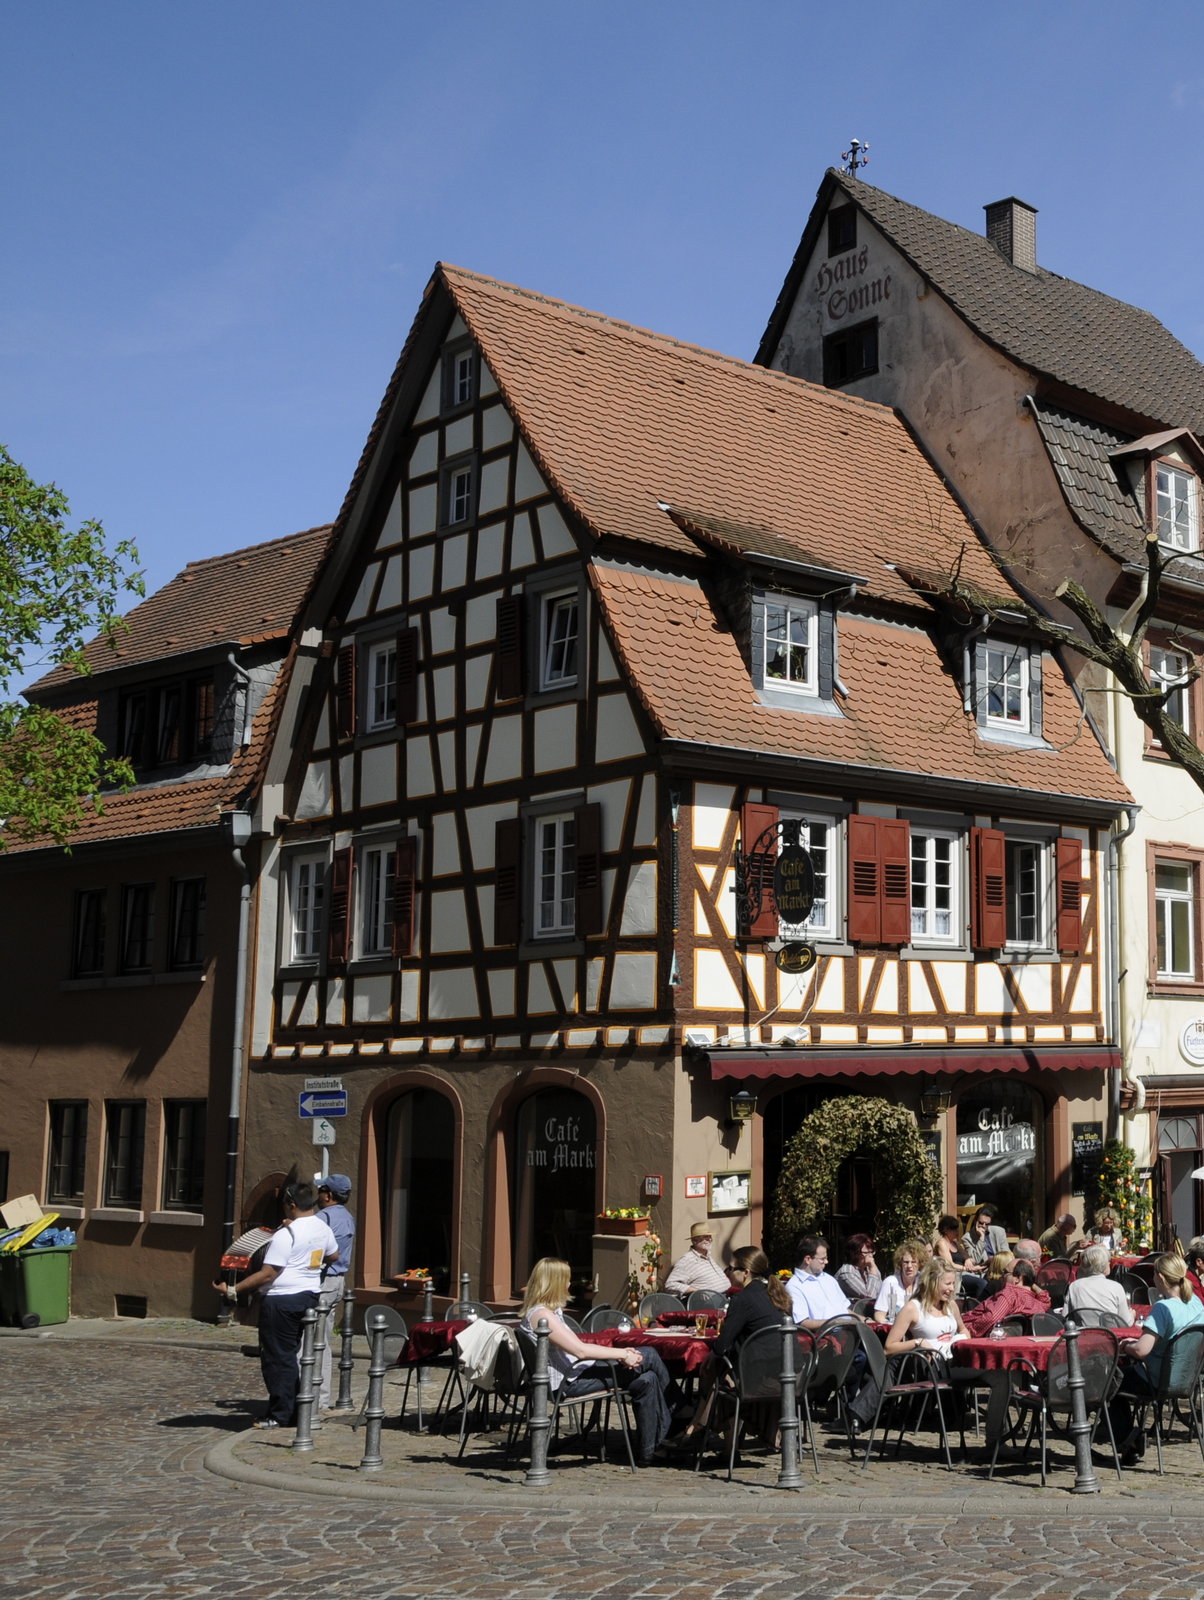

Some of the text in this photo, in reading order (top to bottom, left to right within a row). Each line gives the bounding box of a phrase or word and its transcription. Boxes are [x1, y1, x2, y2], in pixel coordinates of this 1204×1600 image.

[814, 244, 869, 296] Haus
[827, 274, 893, 320] Sonne
[780, 858, 807, 876] Café
[785, 879, 800, 892] am
[777, 894, 810, 910] Markt
[312, 1100, 344, 1108] Einbahnstraße
[545, 1116, 580, 1142] Café
[978, 1106, 1015, 1131] Café
[960, 1136, 983, 1154] am
[986, 1128, 1036, 1159] Markt
[527, 1149, 548, 1167] am
